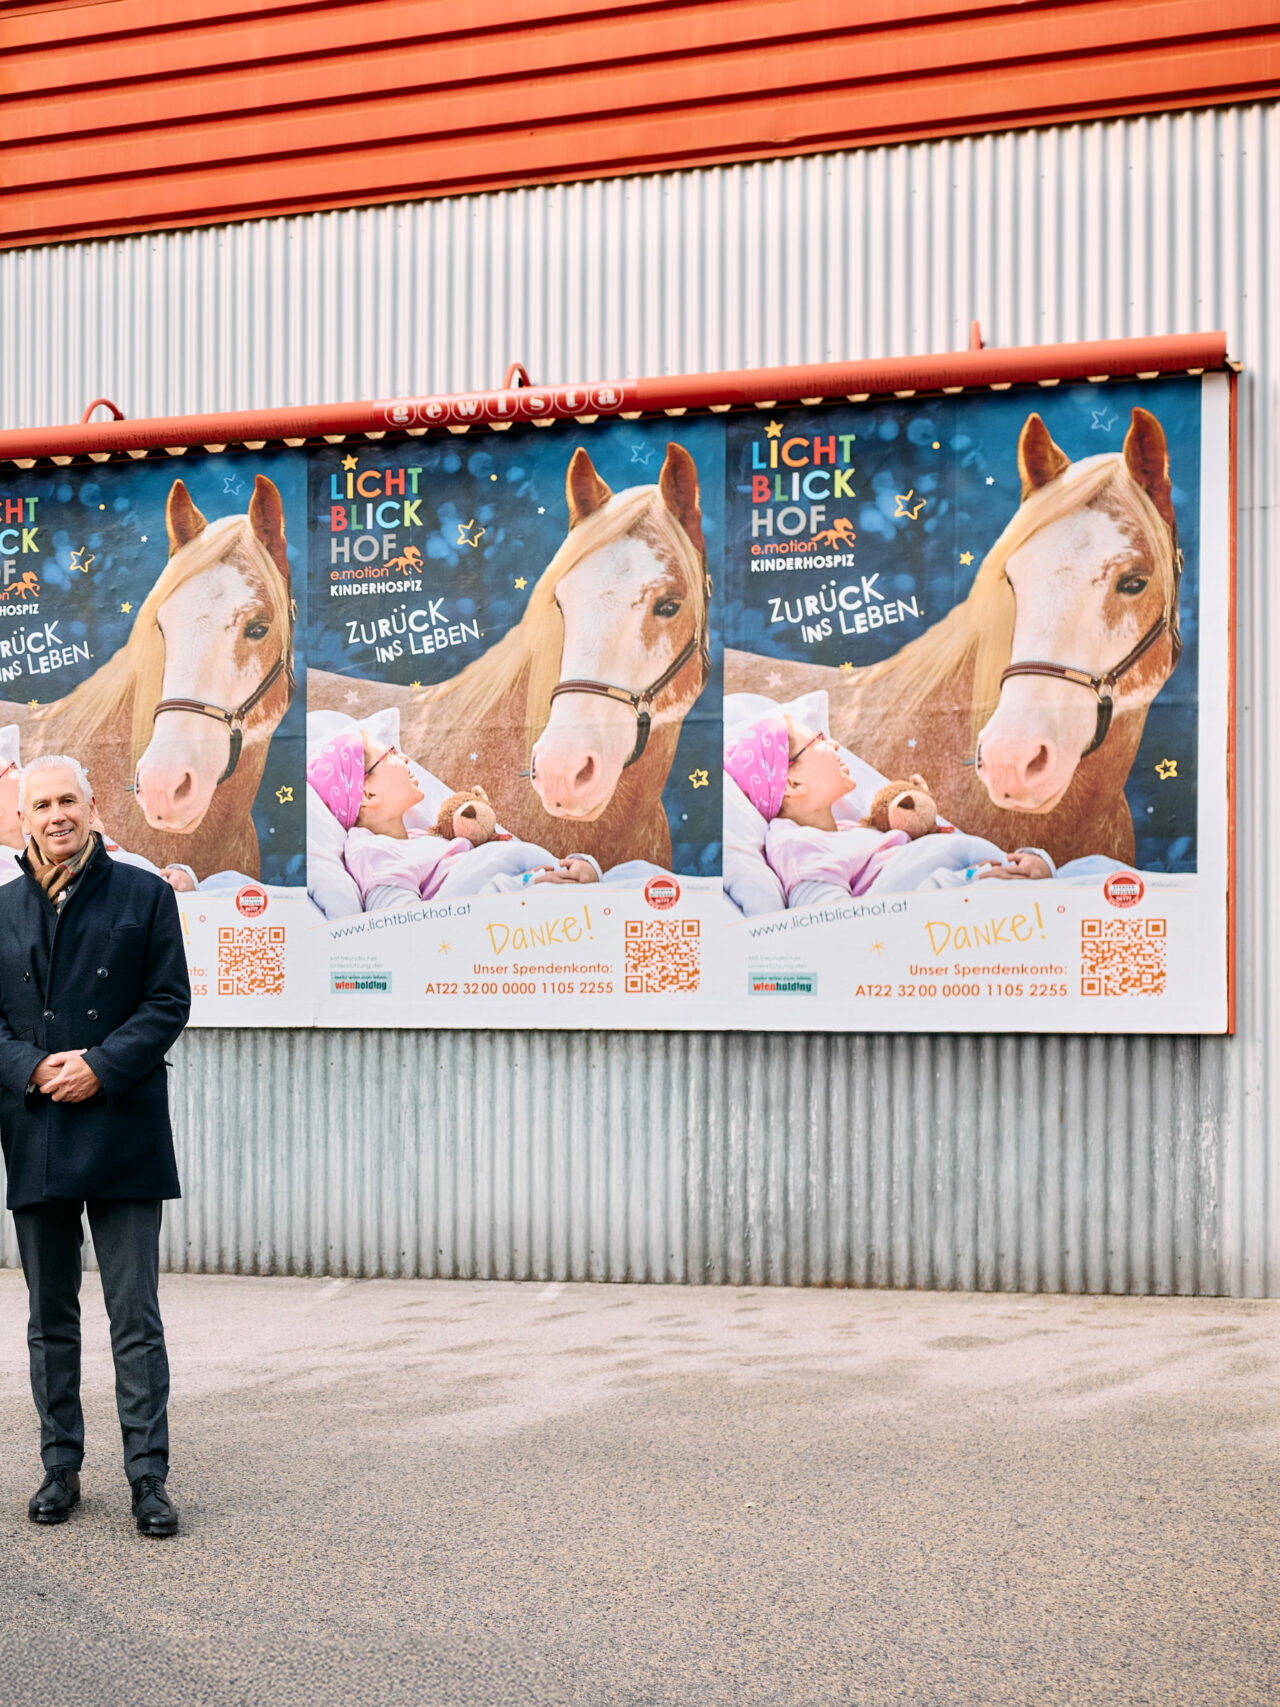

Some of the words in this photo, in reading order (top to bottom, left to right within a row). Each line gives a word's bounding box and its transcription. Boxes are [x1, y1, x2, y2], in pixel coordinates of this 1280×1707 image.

[392, 387, 618, 422] gewista
[752, 434, 856, 469] LICHT
[331, 467, 422, 500] LICHT
[752, 468, 856, 504] BLICK
[331, 499, 423, 531] BLICK
[752, 505, 826, 537] HOF
[331, 533, 397, 564] HOF
[751, 539, 817, 555] e.motion
[751, 554, 855, 572] KINDERHOSPIZ
[330, 565, 389, 581] e.motion
[330, 580, 422, 596] KINDERHOSPIZ
[768, 572, 885, 623] ZURÜCK
[346, 597, 449, 645] ZURÜCK
[801, 618, 832, 643] INS
[839, 596, 924, 635] LEBEN.
[375, 640, 403, 663] INS
[409, 619, 485, 655] LEBEN.
[27, 641, 94, 675] LEBEN.
[330, 903, 471, 939] www.lichtblickhof.at
[749, 900, 908, 938] www.lichtblickhof.at
[335, 980, 387, 990] wienholding
[473, 964, 508, 974] Unser
[513, 963, 613, 976] Spendenkonto:
[910, 964, 948, 975] Unser
[954, 963, 1068, 977] Spendenkonto:
[425, 983, 458, 994] AT22
[463, 983, 498, 994] 3200
[502, 982, 536, 994] 0000
[543, 982, 575, 994] 1105
[579, 982, 613, 994] 2255
[753, 982, 812, 992] wienholding
[855, 984, 892, 997] AT22
[898, 984, 937, 997] 3200
[942, 984, 980, 997] 0000
[988, 984, 1023, 996] 1105
[1029, 984, 1068, 996] 2255
